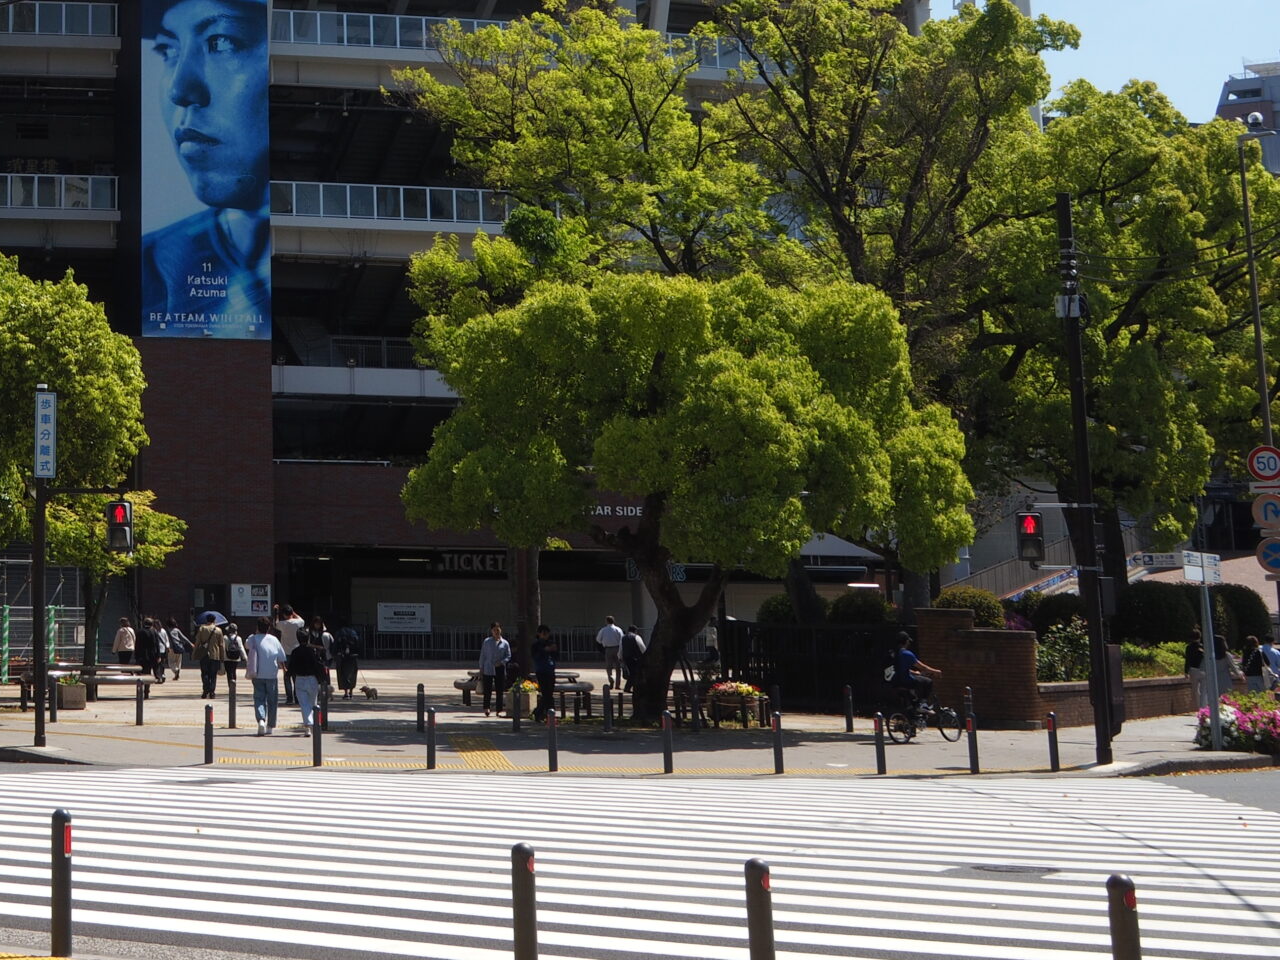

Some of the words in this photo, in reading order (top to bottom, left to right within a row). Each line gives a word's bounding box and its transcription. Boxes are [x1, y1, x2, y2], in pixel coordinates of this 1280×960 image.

[202, 263, 212, 273] 11
[187, 275, 228, 285] Katsuki
[190, 288, 226, 297] Azuma
[150, 313, 162, 321] BE
[164, 313, 172, 321] A
[174, 313, 208, 322] TEAM.
[40, 398, 52, 472] 歩車分離式
[1256, 456, 1277, 471] 50
[615, 506, 643, 517] SIDE
